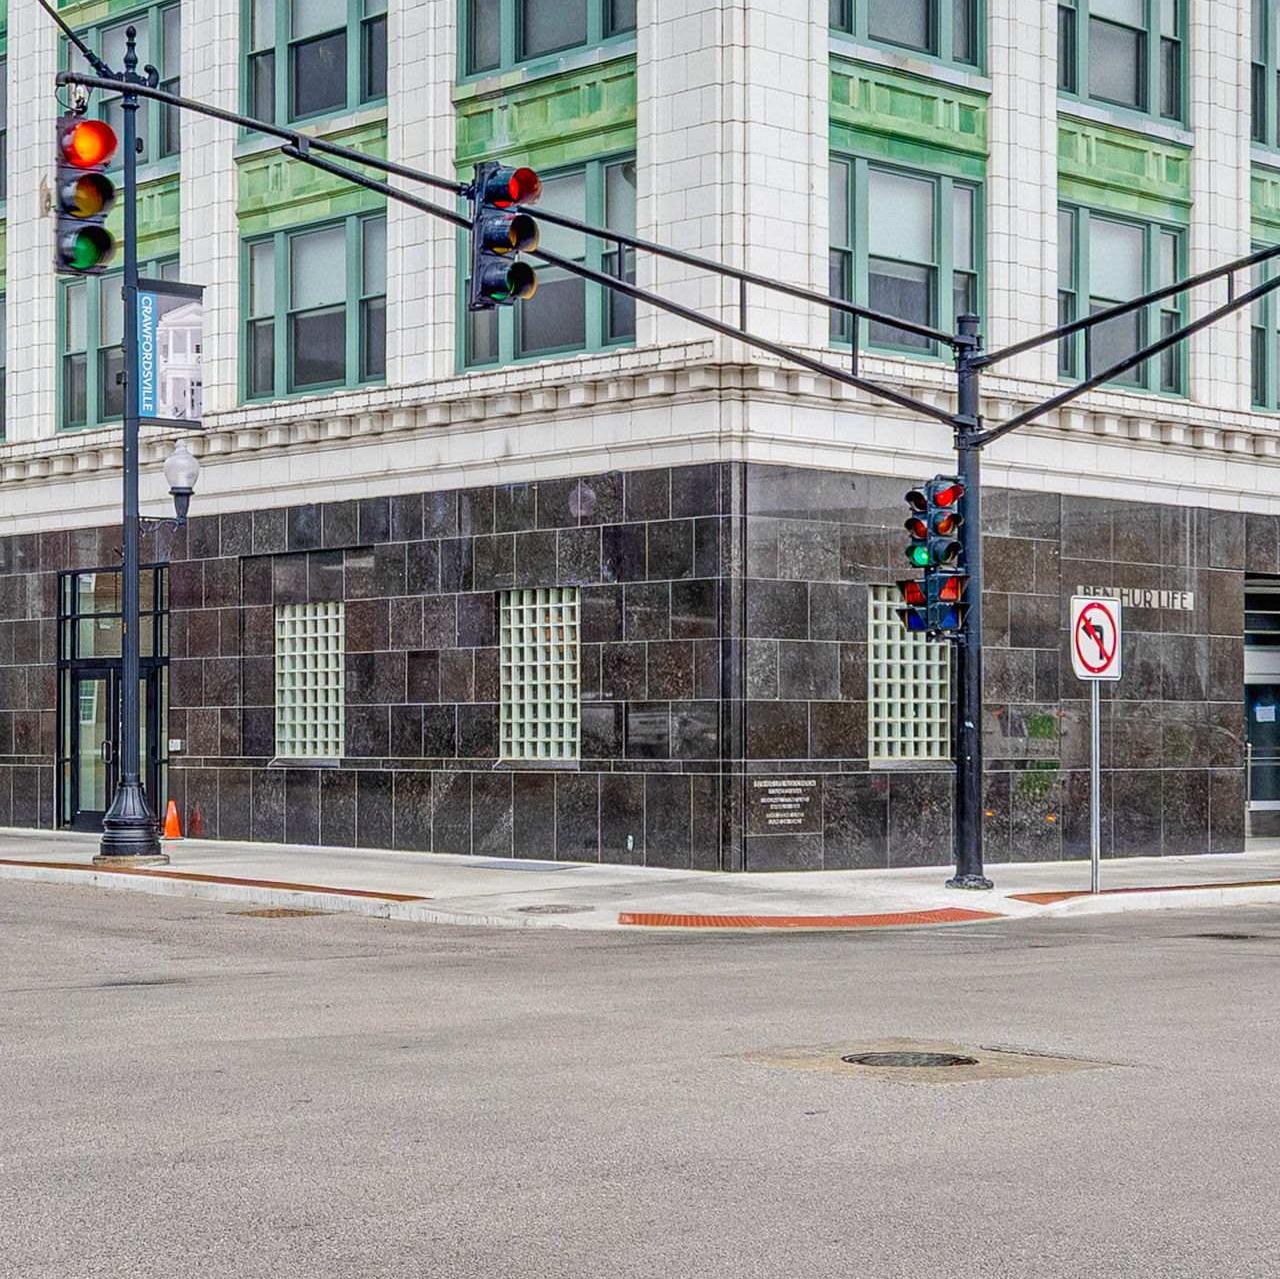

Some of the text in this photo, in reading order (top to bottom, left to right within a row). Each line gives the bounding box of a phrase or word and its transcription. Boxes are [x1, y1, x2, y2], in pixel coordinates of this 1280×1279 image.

[141, 295, 153, 411] CRAWFORDSVILLE
[1120, 588, 1153, 607] HUR
[1158, 590, 1189, 610] LIFE
